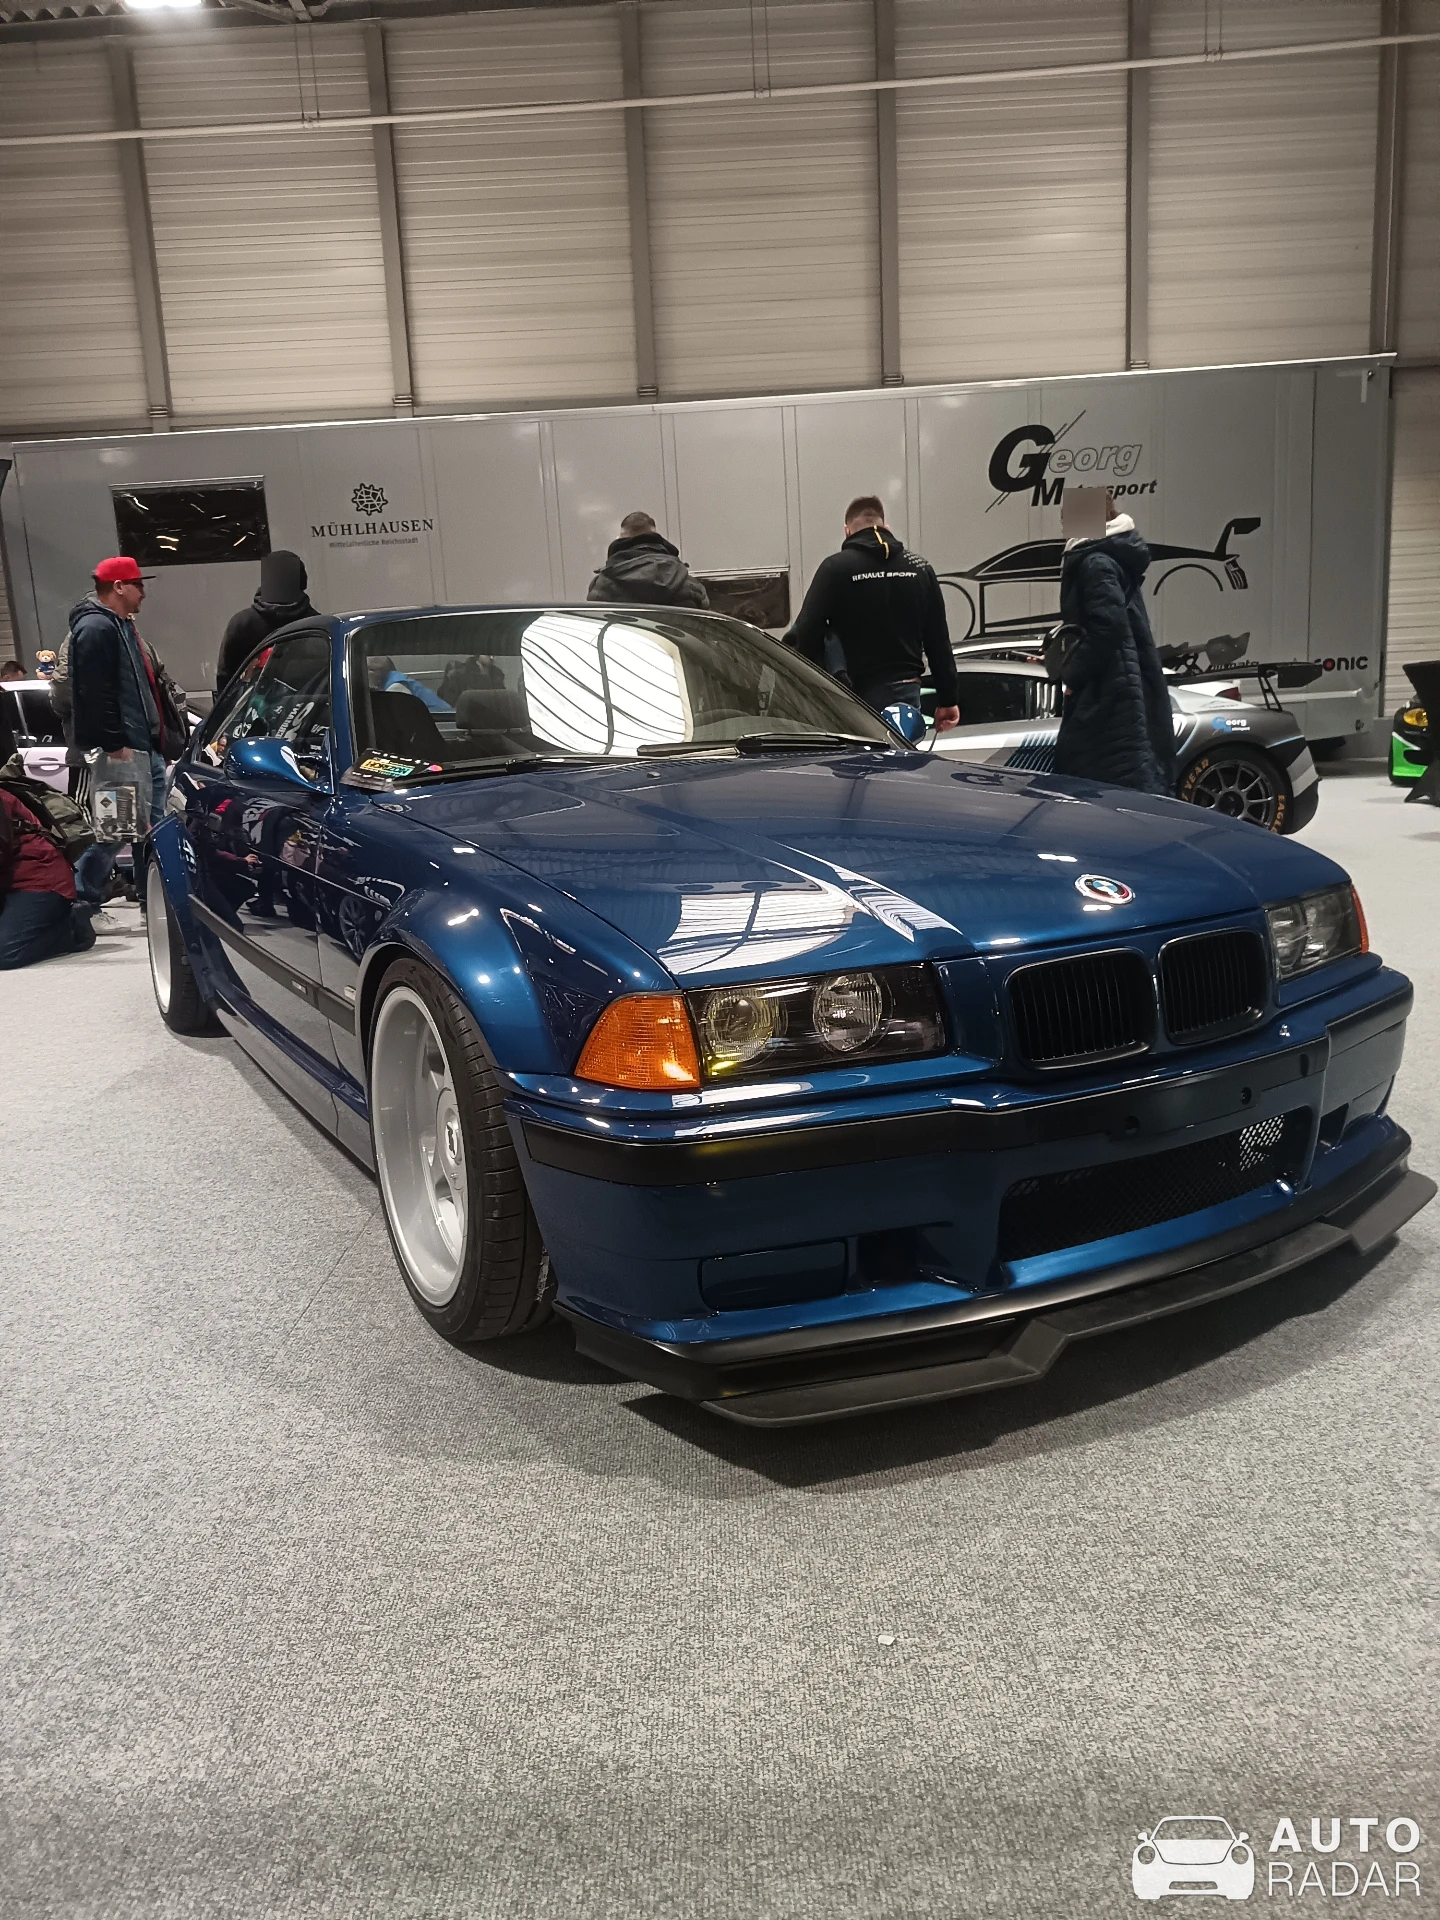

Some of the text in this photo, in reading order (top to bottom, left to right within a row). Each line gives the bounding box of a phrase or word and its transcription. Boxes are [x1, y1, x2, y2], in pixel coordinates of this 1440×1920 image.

[988, 424, 1143, 493] Georg
[1031, 477, 1158, 507] Msport
[311, 519, 434, 538] MÜHLHAUSEN
[852, 571, 885, 581] RENAULT
